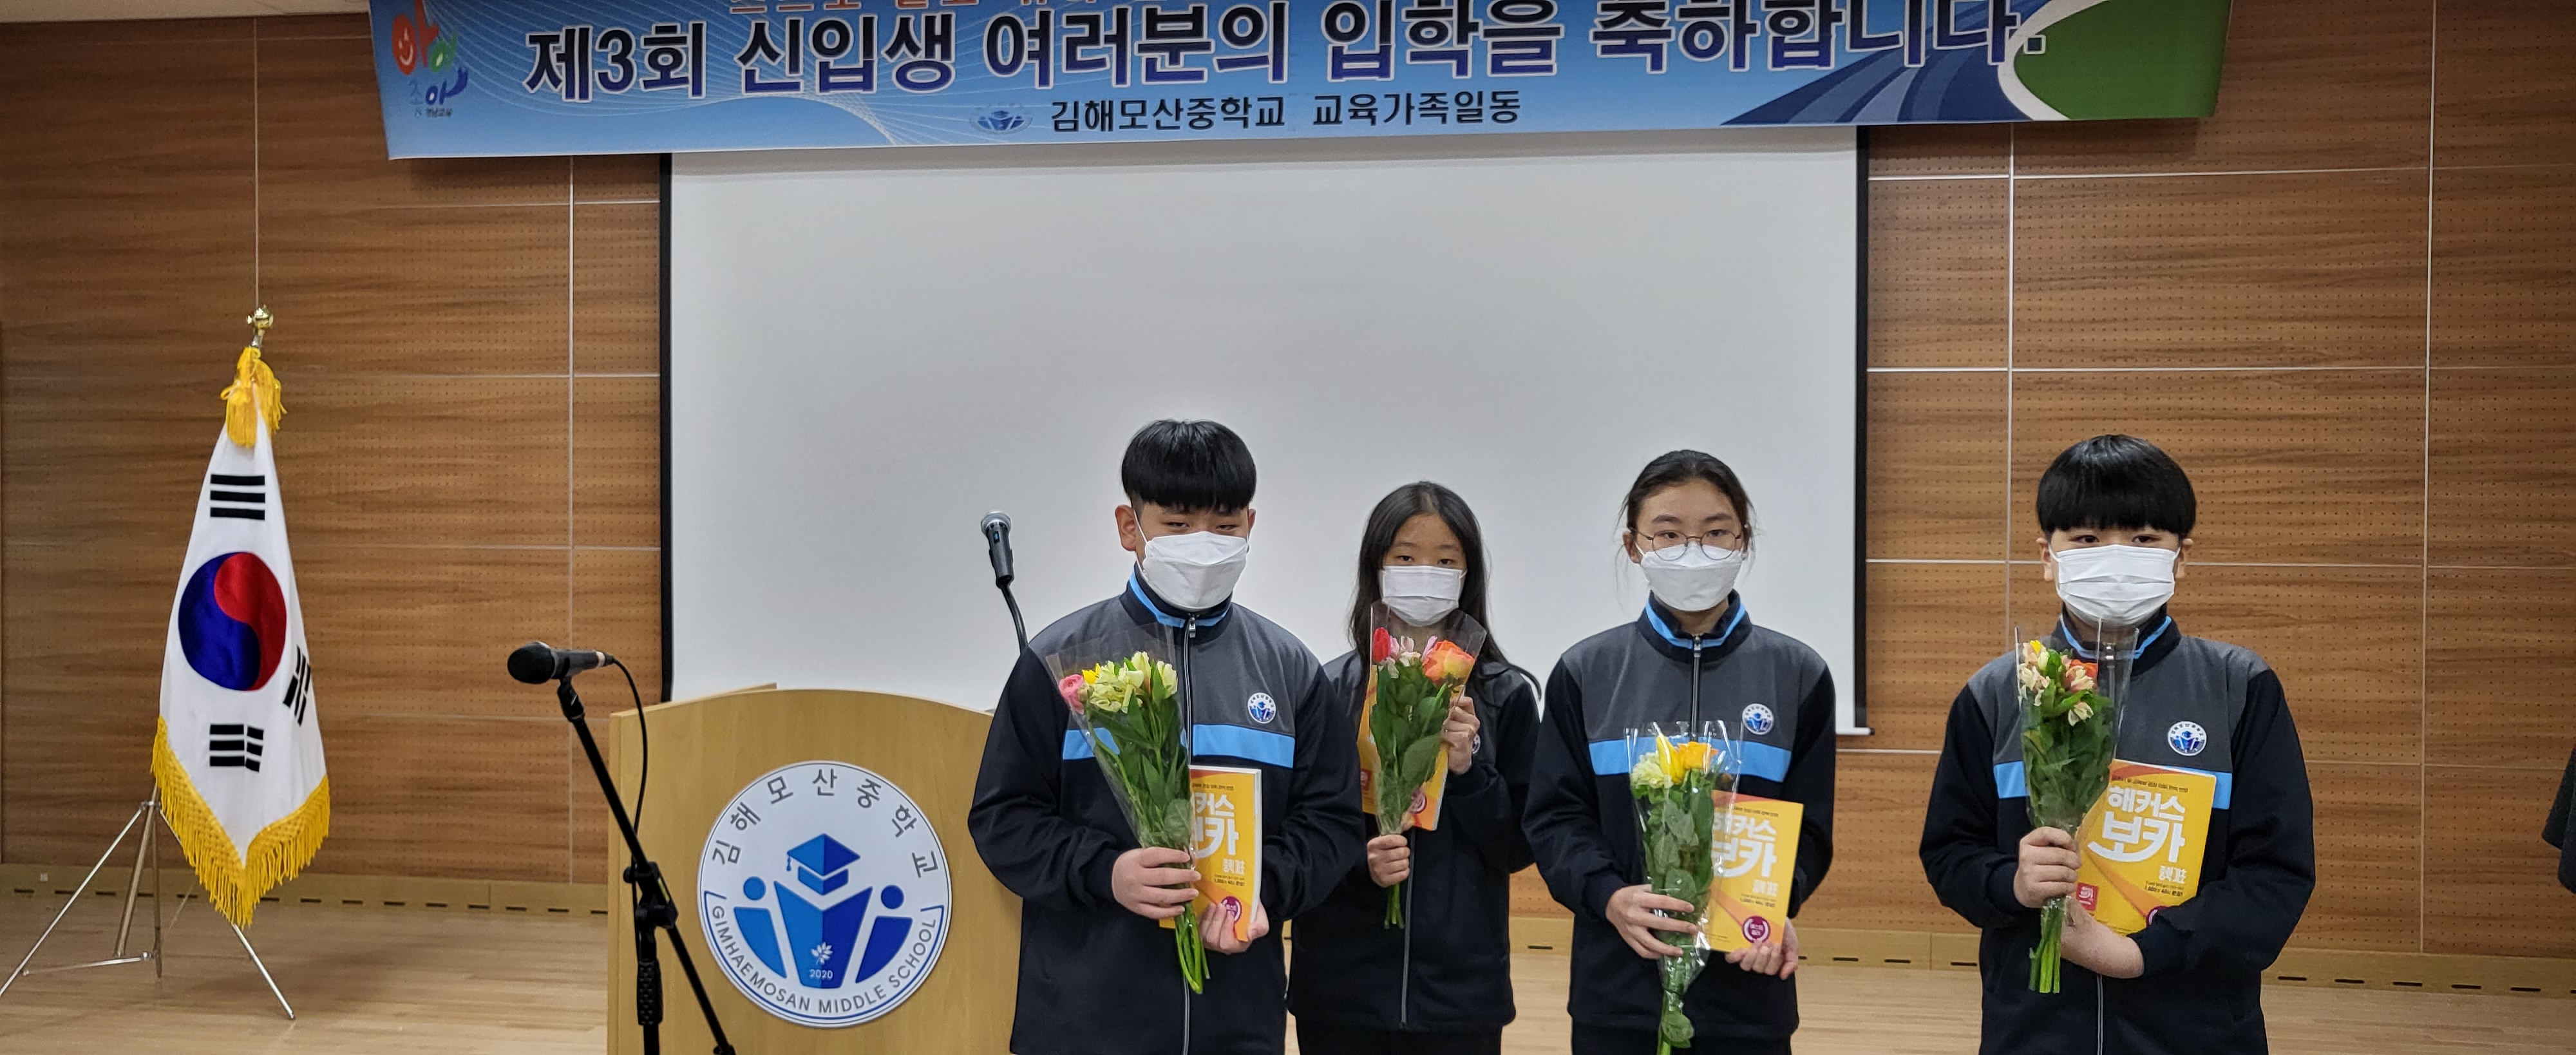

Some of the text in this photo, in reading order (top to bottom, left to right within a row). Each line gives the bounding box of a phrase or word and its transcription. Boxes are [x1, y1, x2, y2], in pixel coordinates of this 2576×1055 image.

[523, 21, 707, 104] 제3회
[734, 11, 956, 95] 신입생
[983, 0, 1288, 89] 여러분의
[1320, 0, 1565, 81] 입학을
[1050, 95, 1286, 133] 김해모산중학교
[1312, 90, 1522, 126] 교육가족일동
[712, 768, 938, 878] 김해모산중학교
[2108, 785, 2186, 821] 해커스
[2087, 811, 2186, 863] 보카
[712, 906, 937, 1014] GIMHAEMOSAN MIDDLE SCHOOL
[809, 969, 833, 980] 2020
